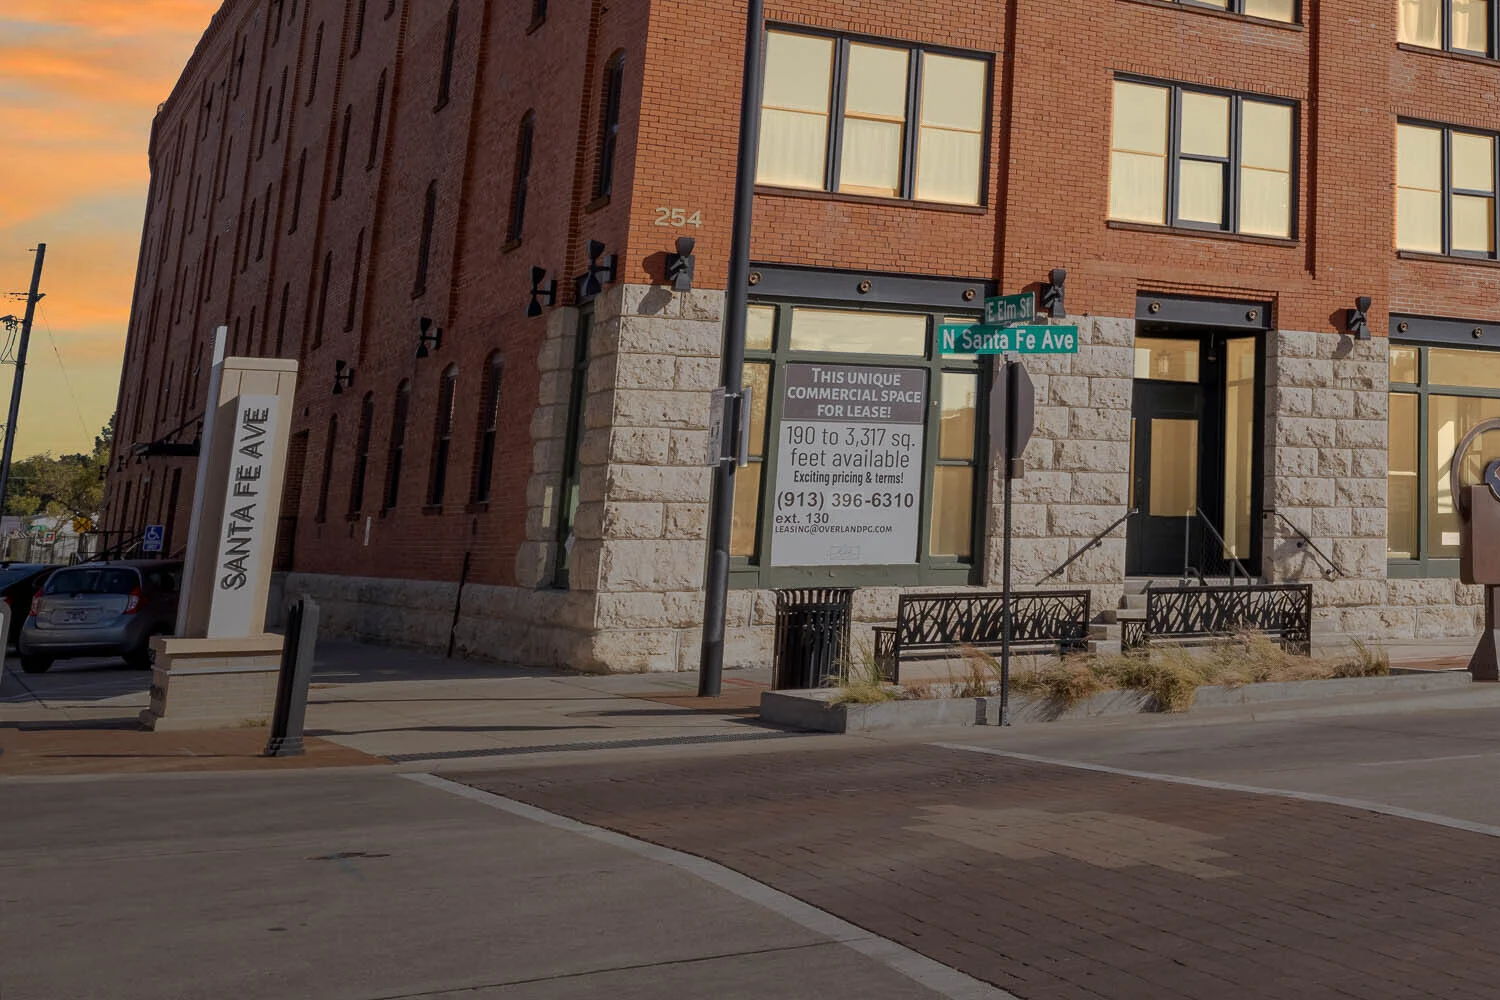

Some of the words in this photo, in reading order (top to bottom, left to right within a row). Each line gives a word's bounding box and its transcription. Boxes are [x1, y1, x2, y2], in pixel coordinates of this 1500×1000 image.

[654, 207, 702, 228] 254
[997, 300, 1017, 320] Elm
[1020, 297, 1031, 318] St
[943, 329, 955, 350] N
[962, 329, 1009, 350] Santa
[1015, 329, 1036, 350] Fe
[1041, 329, 1074, 350] Ave
[847, 371, 901, 388] UNIQUE
[787, 386, 879, 402] COMMERCIAL
[881, 390, 921, 403] SPACE
[817, 404, 844, 417] FOR
[847, 405, 891, 418] LEASE!
[239, 407, 269, 459] AVE
[787, 425, 815, 445] 190
[822, 428, 839, 446] to
[845, 427, 886, 447] 3,317
[891, 432, 916, 451] sq.
[791, 448, 826, 467] feet
[832, 449, 910, 468] available
[233, 464, 262, 497] FE
[794, 470, 830, 485] Exciting
[832, 472, 863, 486] pricing
[865, 472, 872, 484] &
[875, 471, 904, 484] terms!
[777, 491, 824, 511] (913)
[831, 492, 914, 508] 396-6310
[775, 513, 800, 524] ext.
[806, 513, 829, 524] 130
[775, 524, 892, 535] LEASING@OVERLANDPG.COM
[220, 503, 257, 591] SANTA
